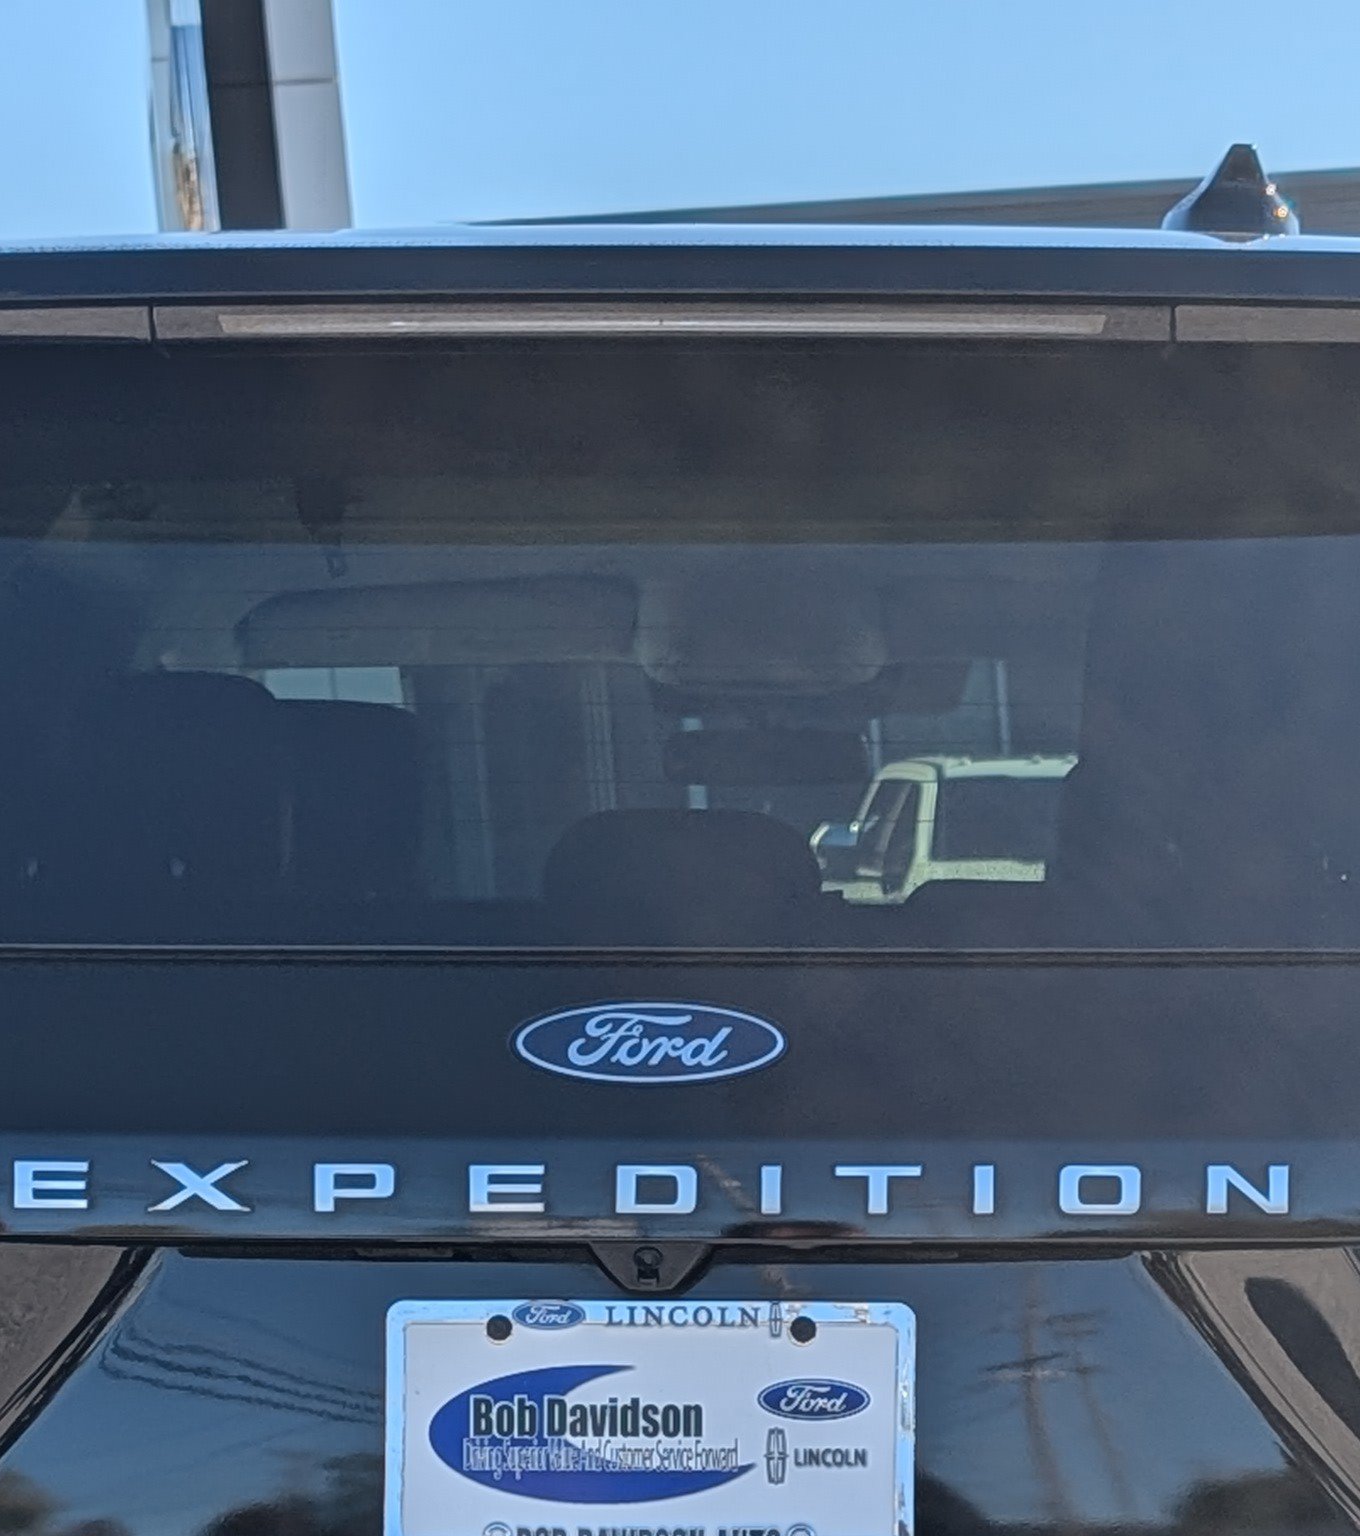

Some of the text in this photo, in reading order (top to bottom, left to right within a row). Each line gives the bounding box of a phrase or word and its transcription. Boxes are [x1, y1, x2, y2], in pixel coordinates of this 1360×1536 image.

[567, 1012, 733, 1067] Ford
[11, 1158, 1292, 1216] EXPEDITION
[605, 1304, 762, 1328] LINCOLN
[780, 1384, 848, 1412] Ford
[471, 1396, 704, 1438] Bob Davidson
[602, 1439, 656, 1473] Customer
[656, 1439, 693, 1472] Service
[693, 1438, 739, 1472] Forward
[793, 1447, 868, 1468] LINCOLN
